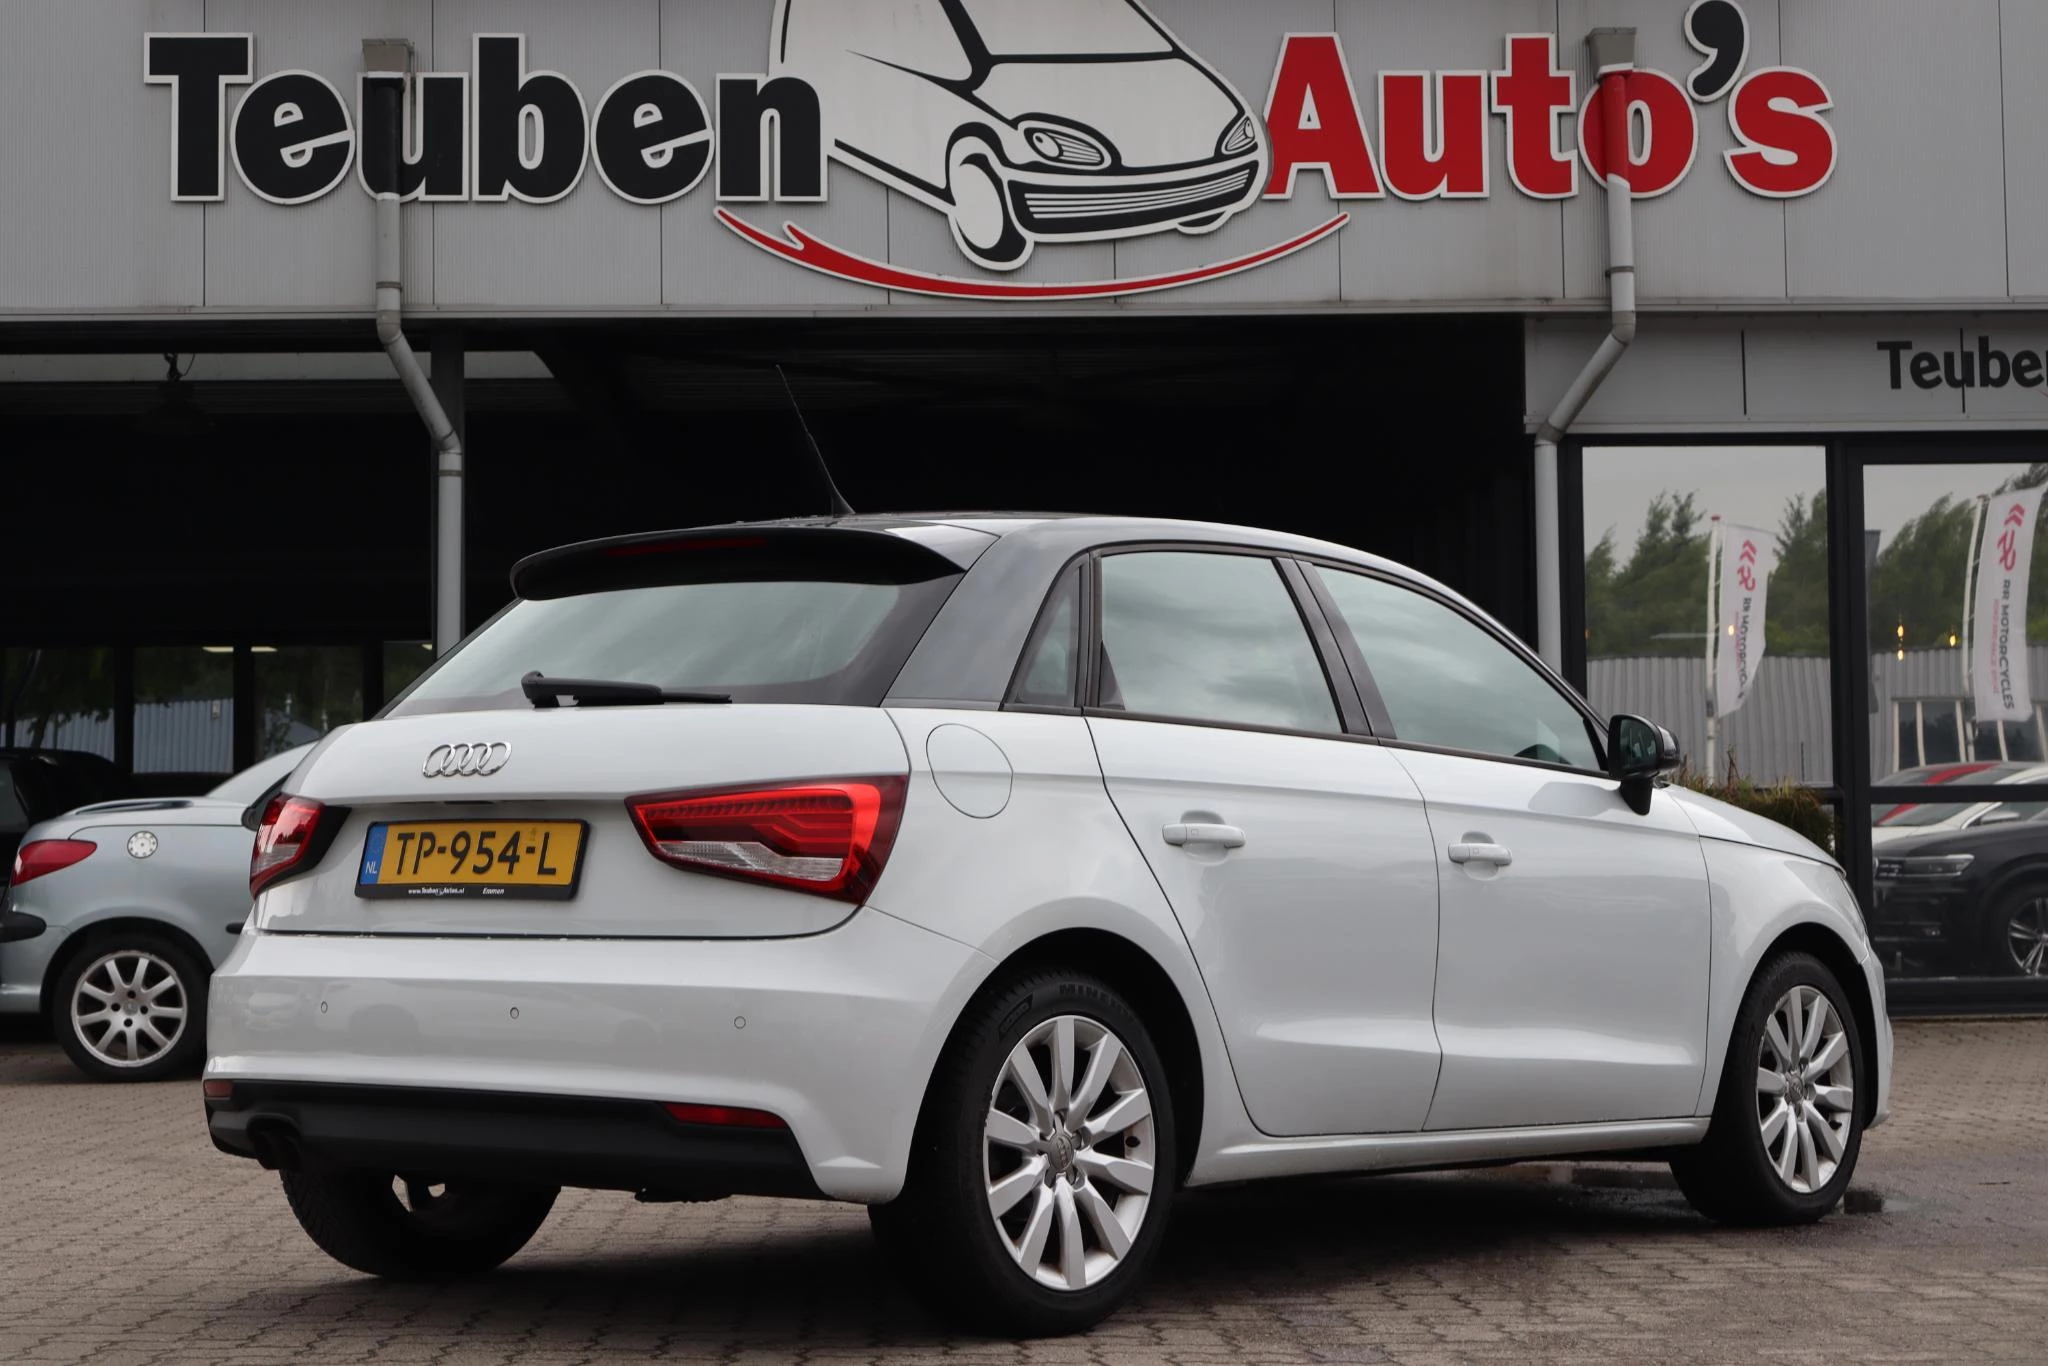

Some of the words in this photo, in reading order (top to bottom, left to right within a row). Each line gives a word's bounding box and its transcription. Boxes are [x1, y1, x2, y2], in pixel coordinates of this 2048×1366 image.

[145, 33, 827, 204] Teuben
[1263, 0, 1837, 198] Auto's
[1876, 335, 2048, 390] Teube
[2001, 579, 2011, 600] RR
[1999, 604, 2016, 710] MOTORCYCLES
[365, 861, 378, 875] NL
[395, 830, 557, 876] TP-954-L
[482, 887, 505, 895] Emmen
